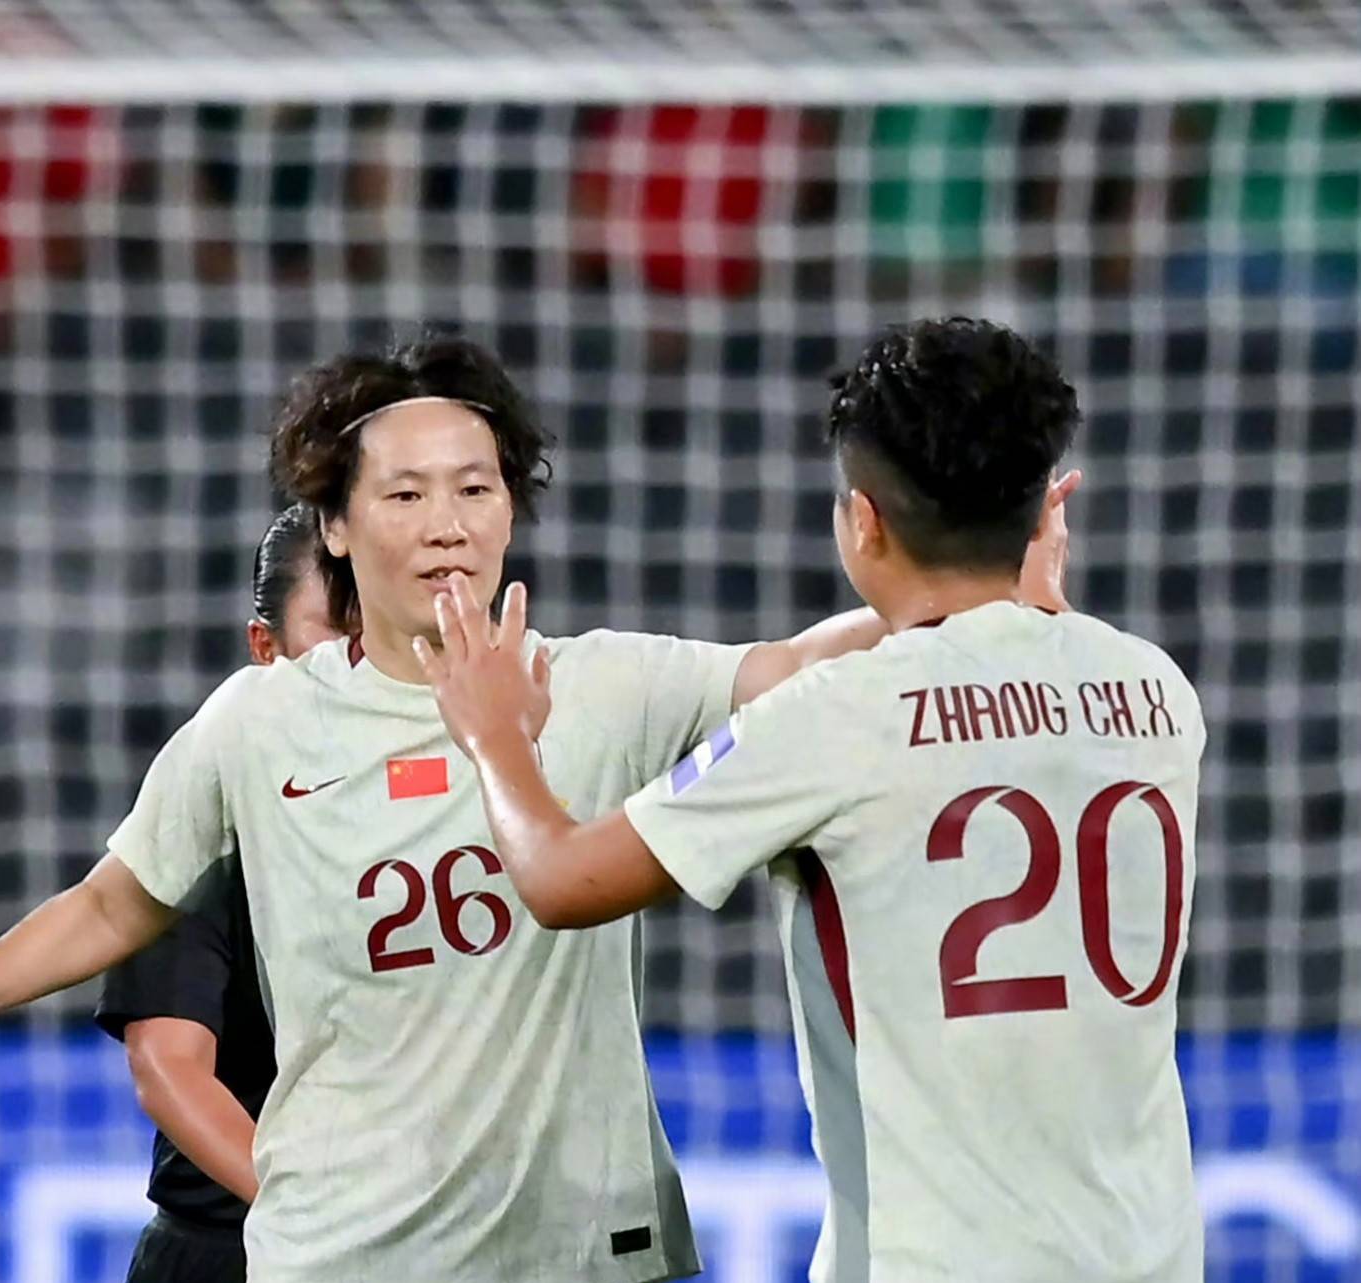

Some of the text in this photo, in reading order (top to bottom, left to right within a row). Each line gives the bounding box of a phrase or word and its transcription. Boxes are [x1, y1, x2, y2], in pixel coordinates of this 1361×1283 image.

[899, 681, 1068, 747] ZHANG
[357, 845, 512, 973] 26
[926, 780, 1184, 1020] 20
